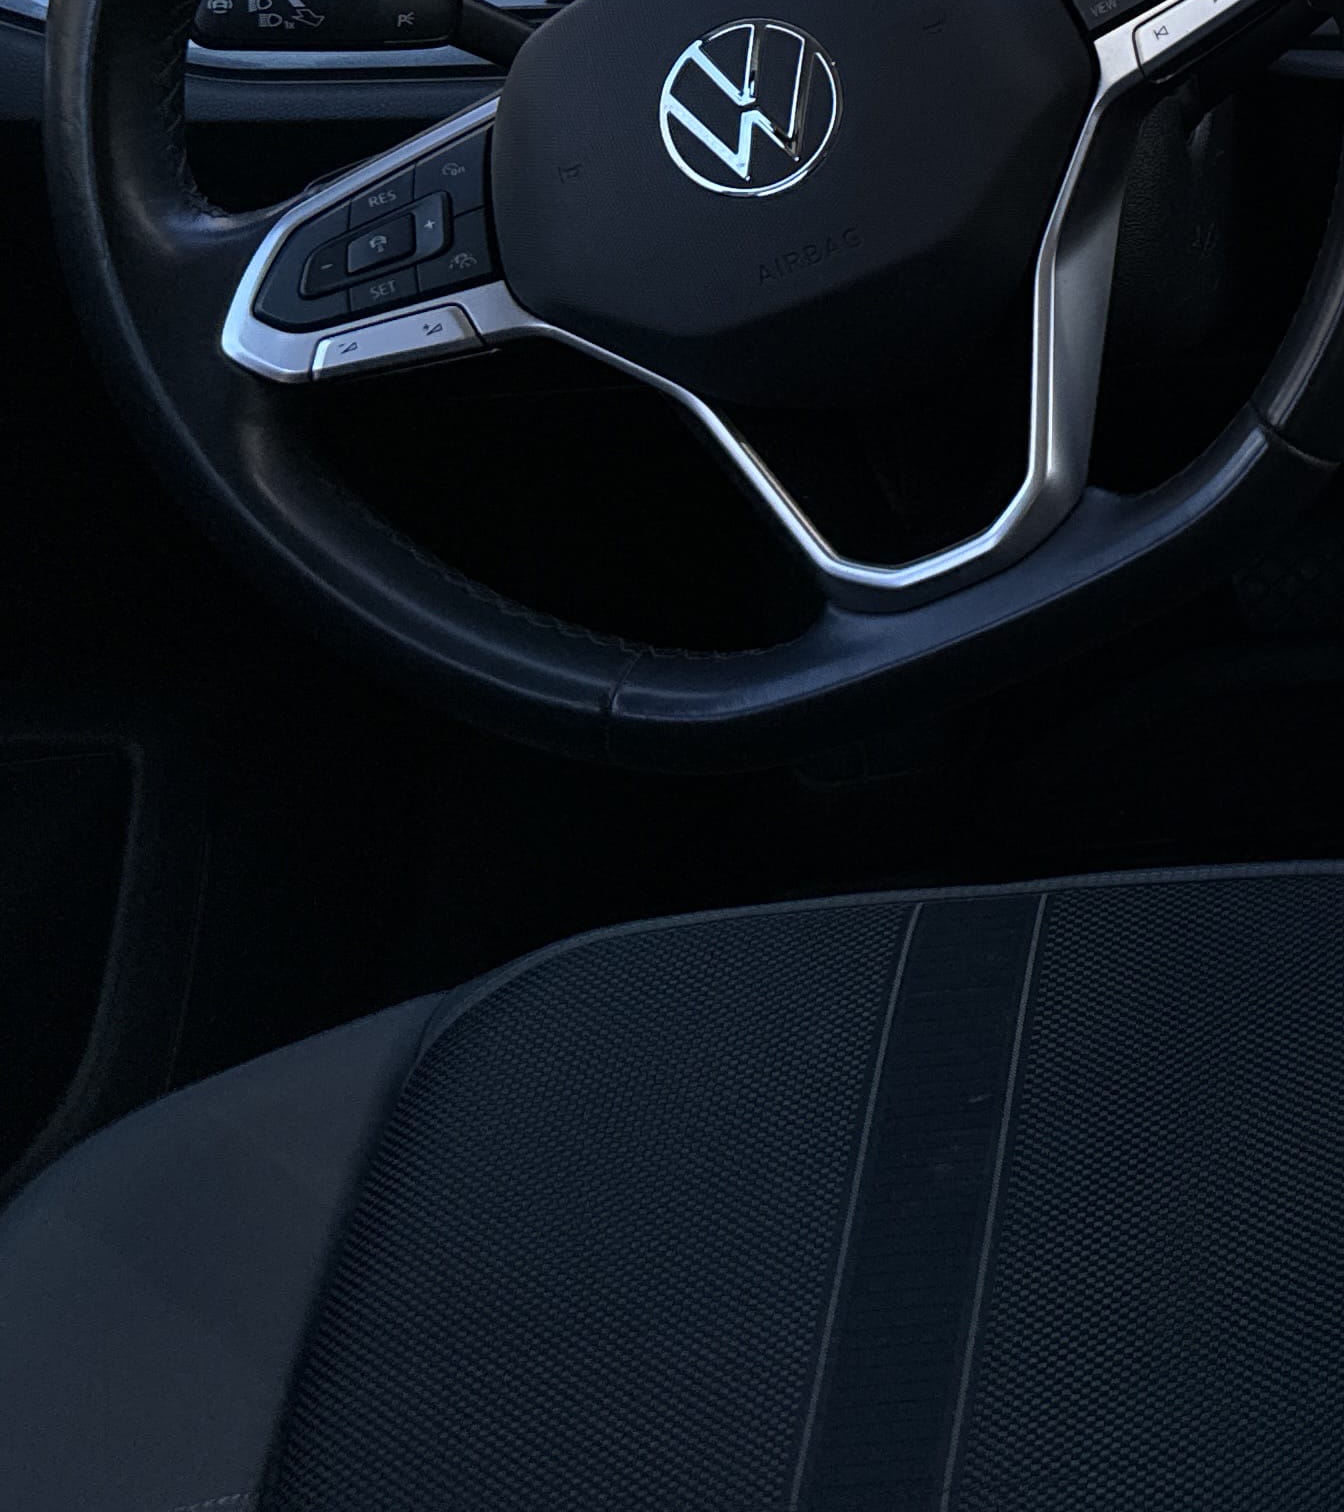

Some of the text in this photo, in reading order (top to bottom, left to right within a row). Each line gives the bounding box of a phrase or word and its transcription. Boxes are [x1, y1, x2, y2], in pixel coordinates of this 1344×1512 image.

[367, 190, 398, 208] RES
[757, 226, 863, 286] AIRBAG
[369, 279, 397, 299] SET
